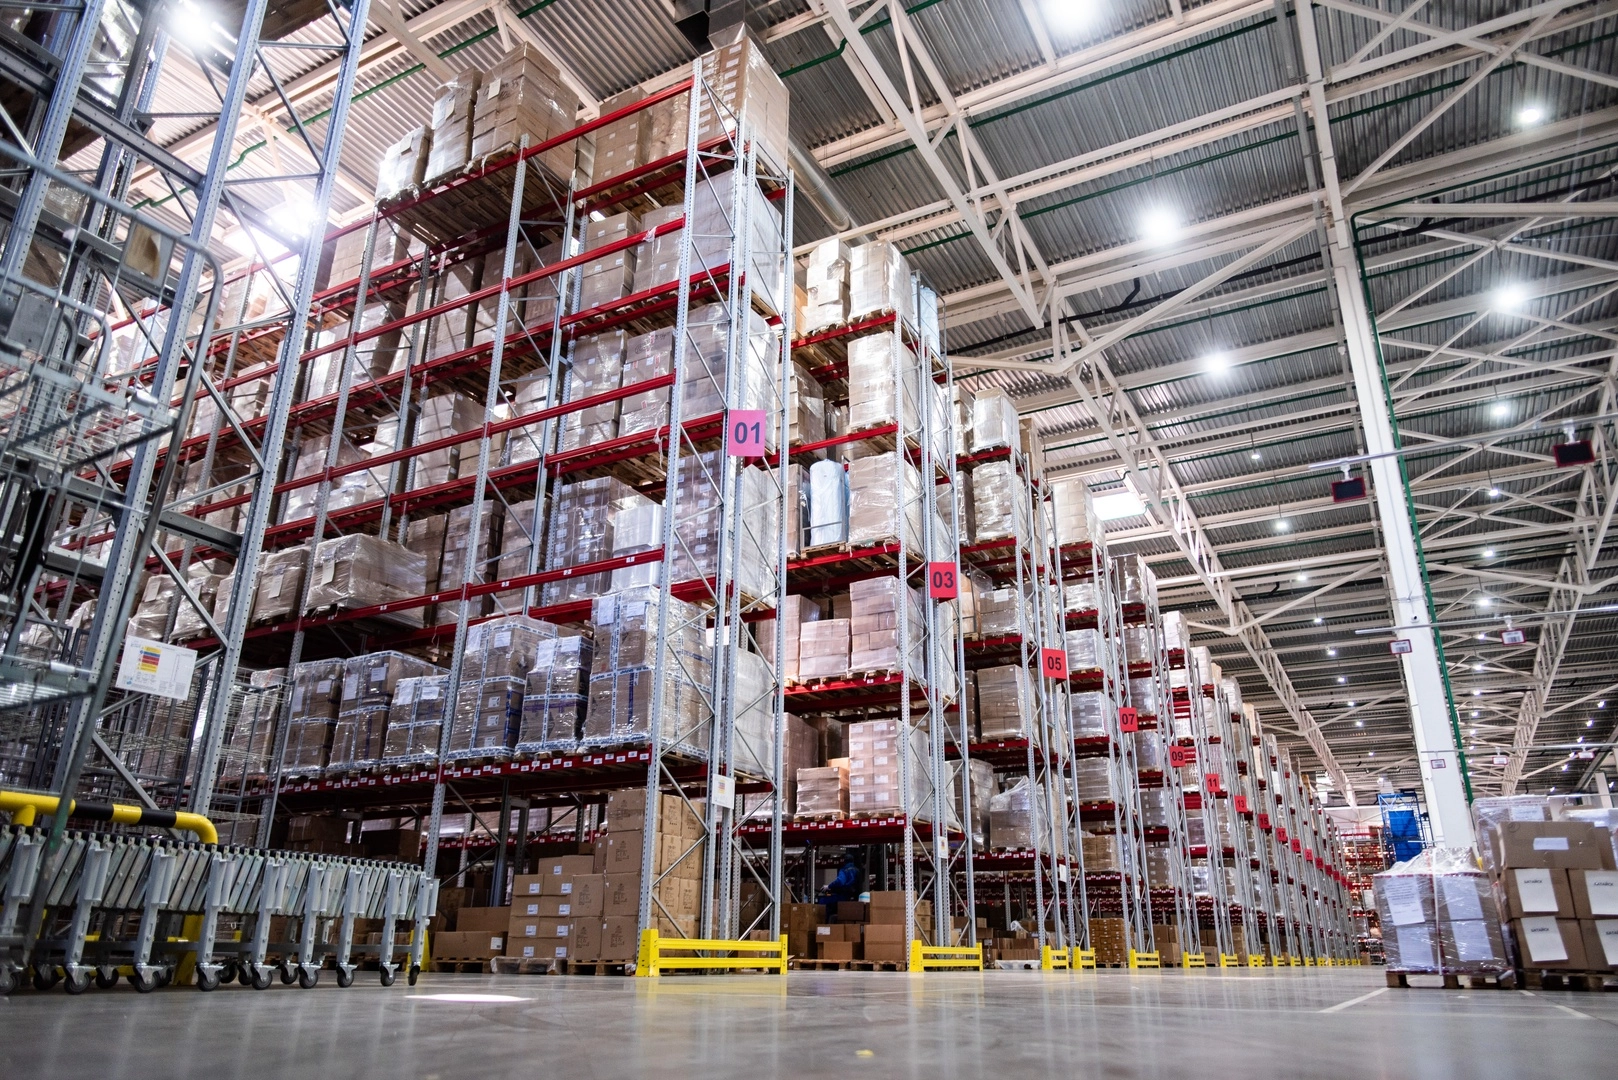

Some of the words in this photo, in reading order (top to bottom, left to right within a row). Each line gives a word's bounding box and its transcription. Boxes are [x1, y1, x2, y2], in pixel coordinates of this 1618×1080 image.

[734, 421, 760, 444] 01
[933, 571, 954, 588] 03
[1047, 656, 1062, 671] 05
[1121, 713, 1135, 725] 07
[1171, 751, 1184, 761] 09
[1208, 778, 1218, 787] 11
[1237, 800, 1245, 808] 13
[1260, 817, 1269, 825] 15
